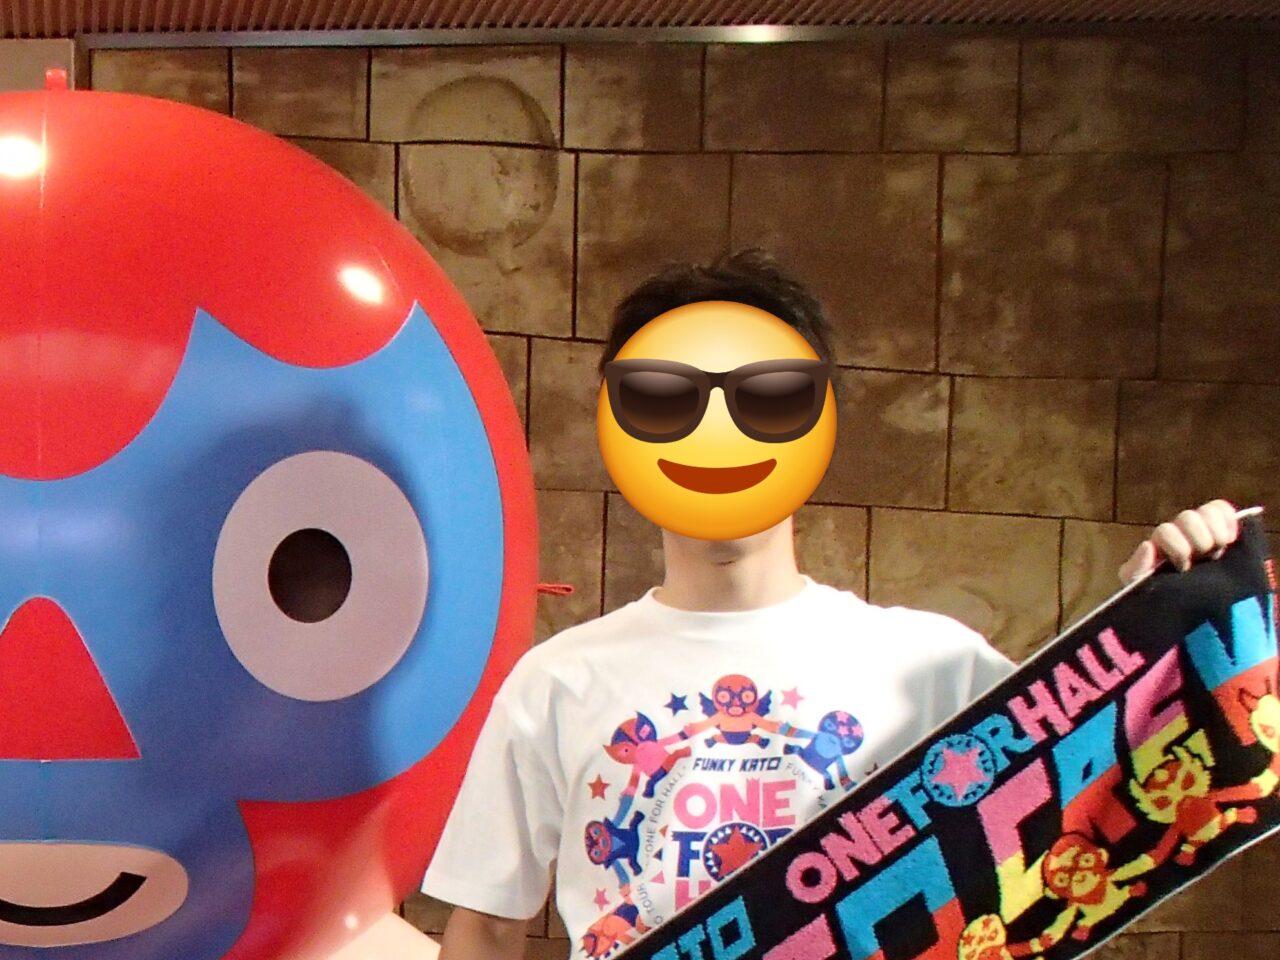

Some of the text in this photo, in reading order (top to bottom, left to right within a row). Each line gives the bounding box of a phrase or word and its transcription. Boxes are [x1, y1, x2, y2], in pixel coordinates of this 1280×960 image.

[693, 756, 782, 772] FUNKY KATO
[673, 778, 797, 829] ONE
